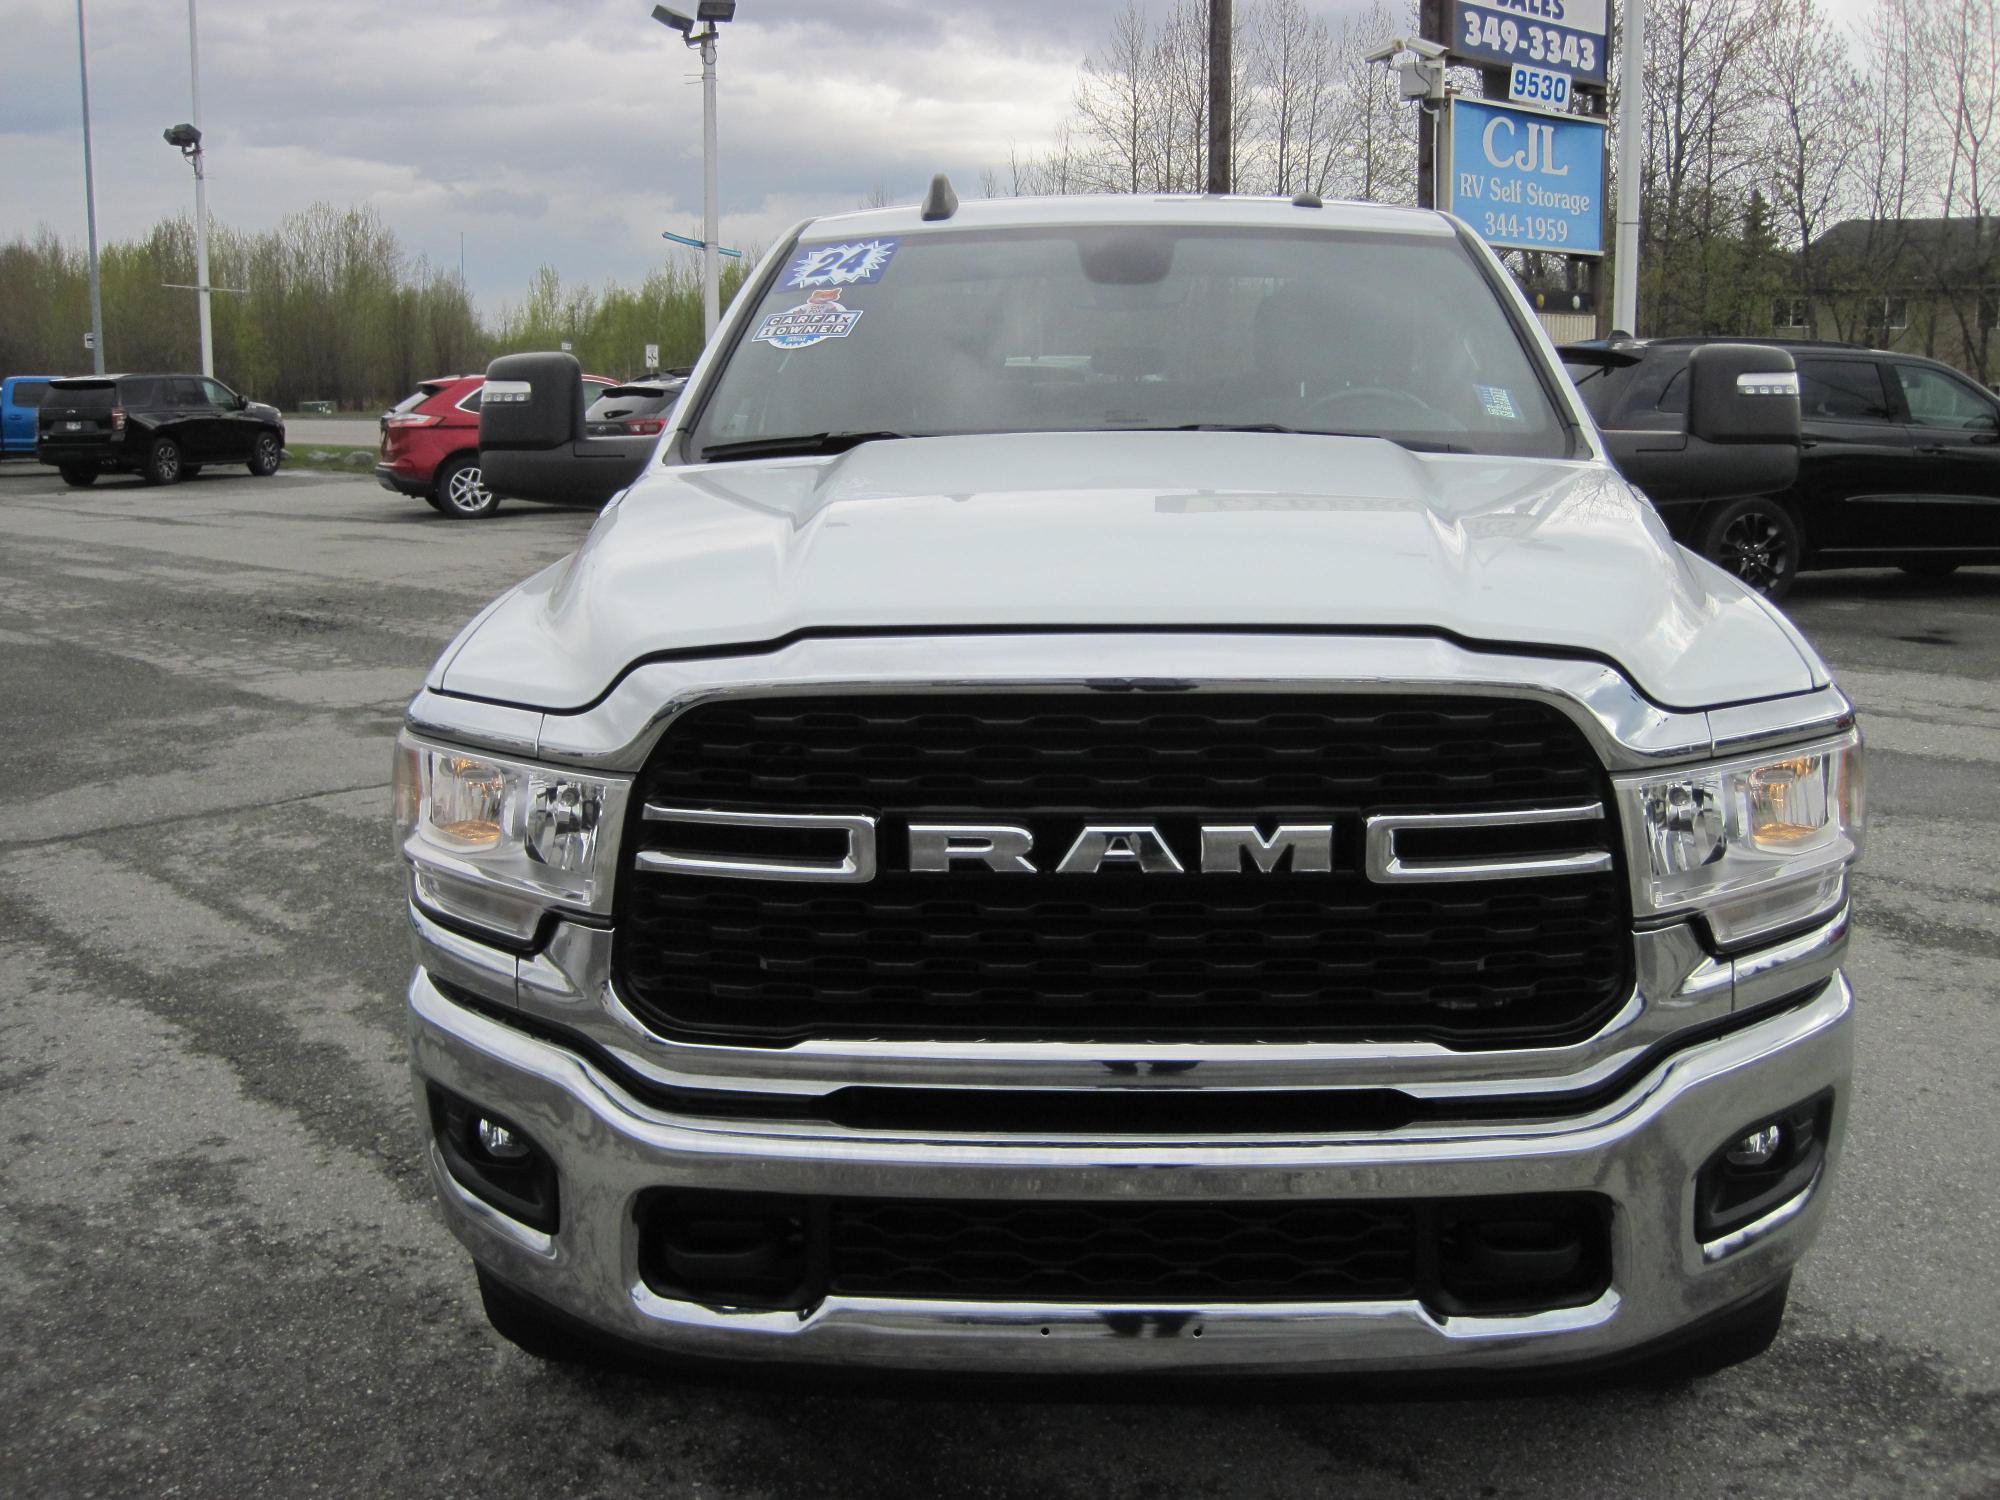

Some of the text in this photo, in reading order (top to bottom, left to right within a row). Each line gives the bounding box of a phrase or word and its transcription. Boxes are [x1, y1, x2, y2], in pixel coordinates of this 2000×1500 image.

[1496, 0, 1564, 20] LES
[1464, 11, 1595, 71] 349-3343
[1513, 69, 1566, 103] 9530
[1482, 116, 1569, 176] CJL
[1460, 173, 1590, 215] RV Self Storage
[1484, 211, 1568, 242] 344-1959
[805, 248, 872, 278] 24
[770, 314, 850, 326] CARFAX
[908, 824, 1333, 873] RAM
